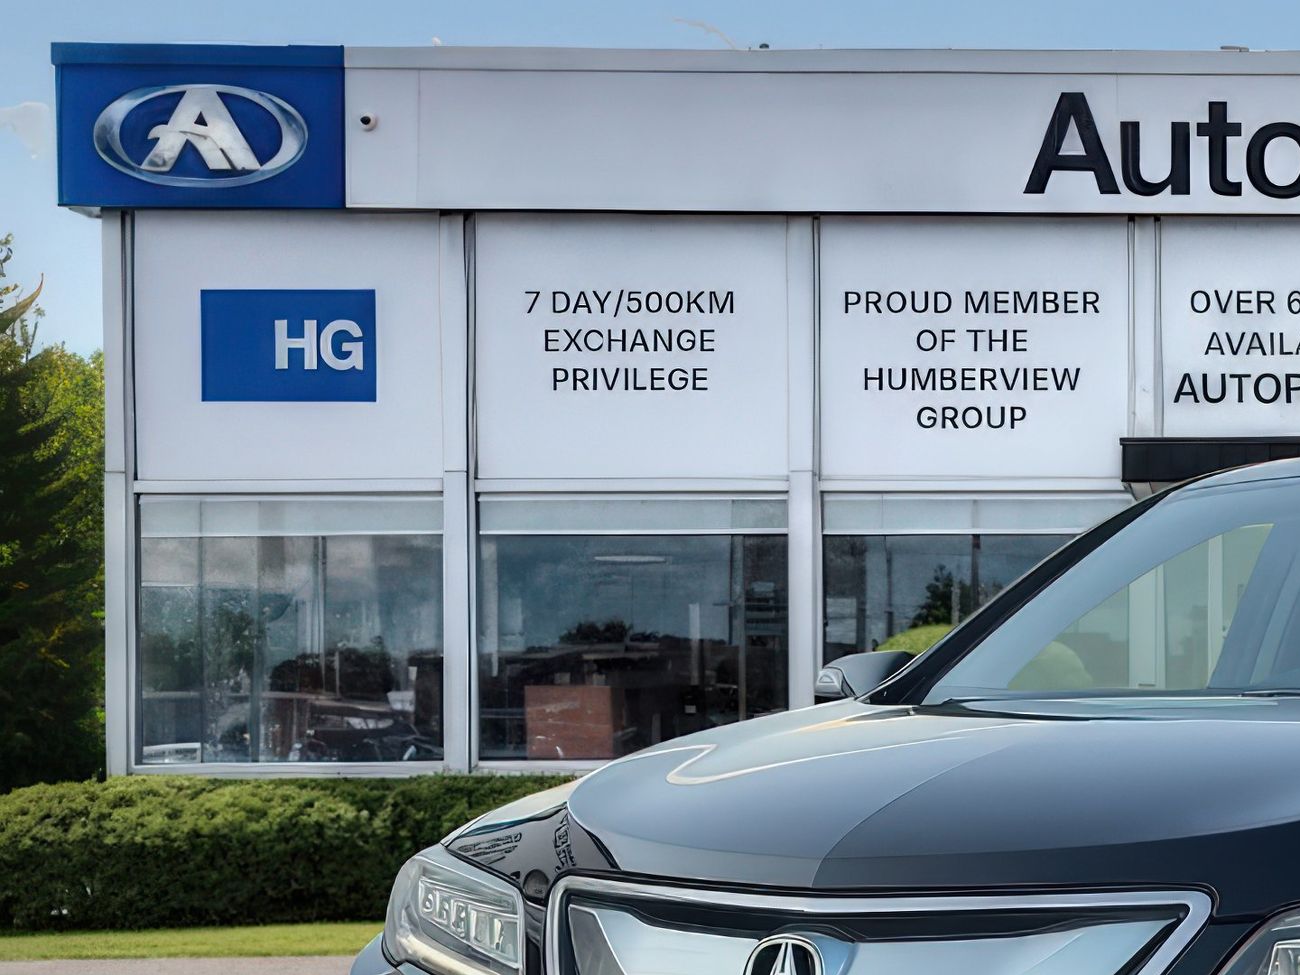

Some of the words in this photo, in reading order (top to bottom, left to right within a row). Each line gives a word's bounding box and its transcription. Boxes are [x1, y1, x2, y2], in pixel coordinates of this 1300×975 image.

[524, 290, 541, 314] 7
[551, 289, 735, 317] DAY/500KM
[844, 290, 953, 314] PROUD
[964, 290, 1100, 314] MEMBER
[1190, 289, 1276, 315] OVER
[274, 319, 364, 371] HG
[544, 328, 715, 353] EXCHANGE
[916, 329, 956, 352] OF
[965, 328, 1028, 352] THE
[552, 367, 709, 391] PRIVILEGE
[864, 367, 1081, 391] HUMBERVIEW
[916, 406, 1027, 430] GROUP
